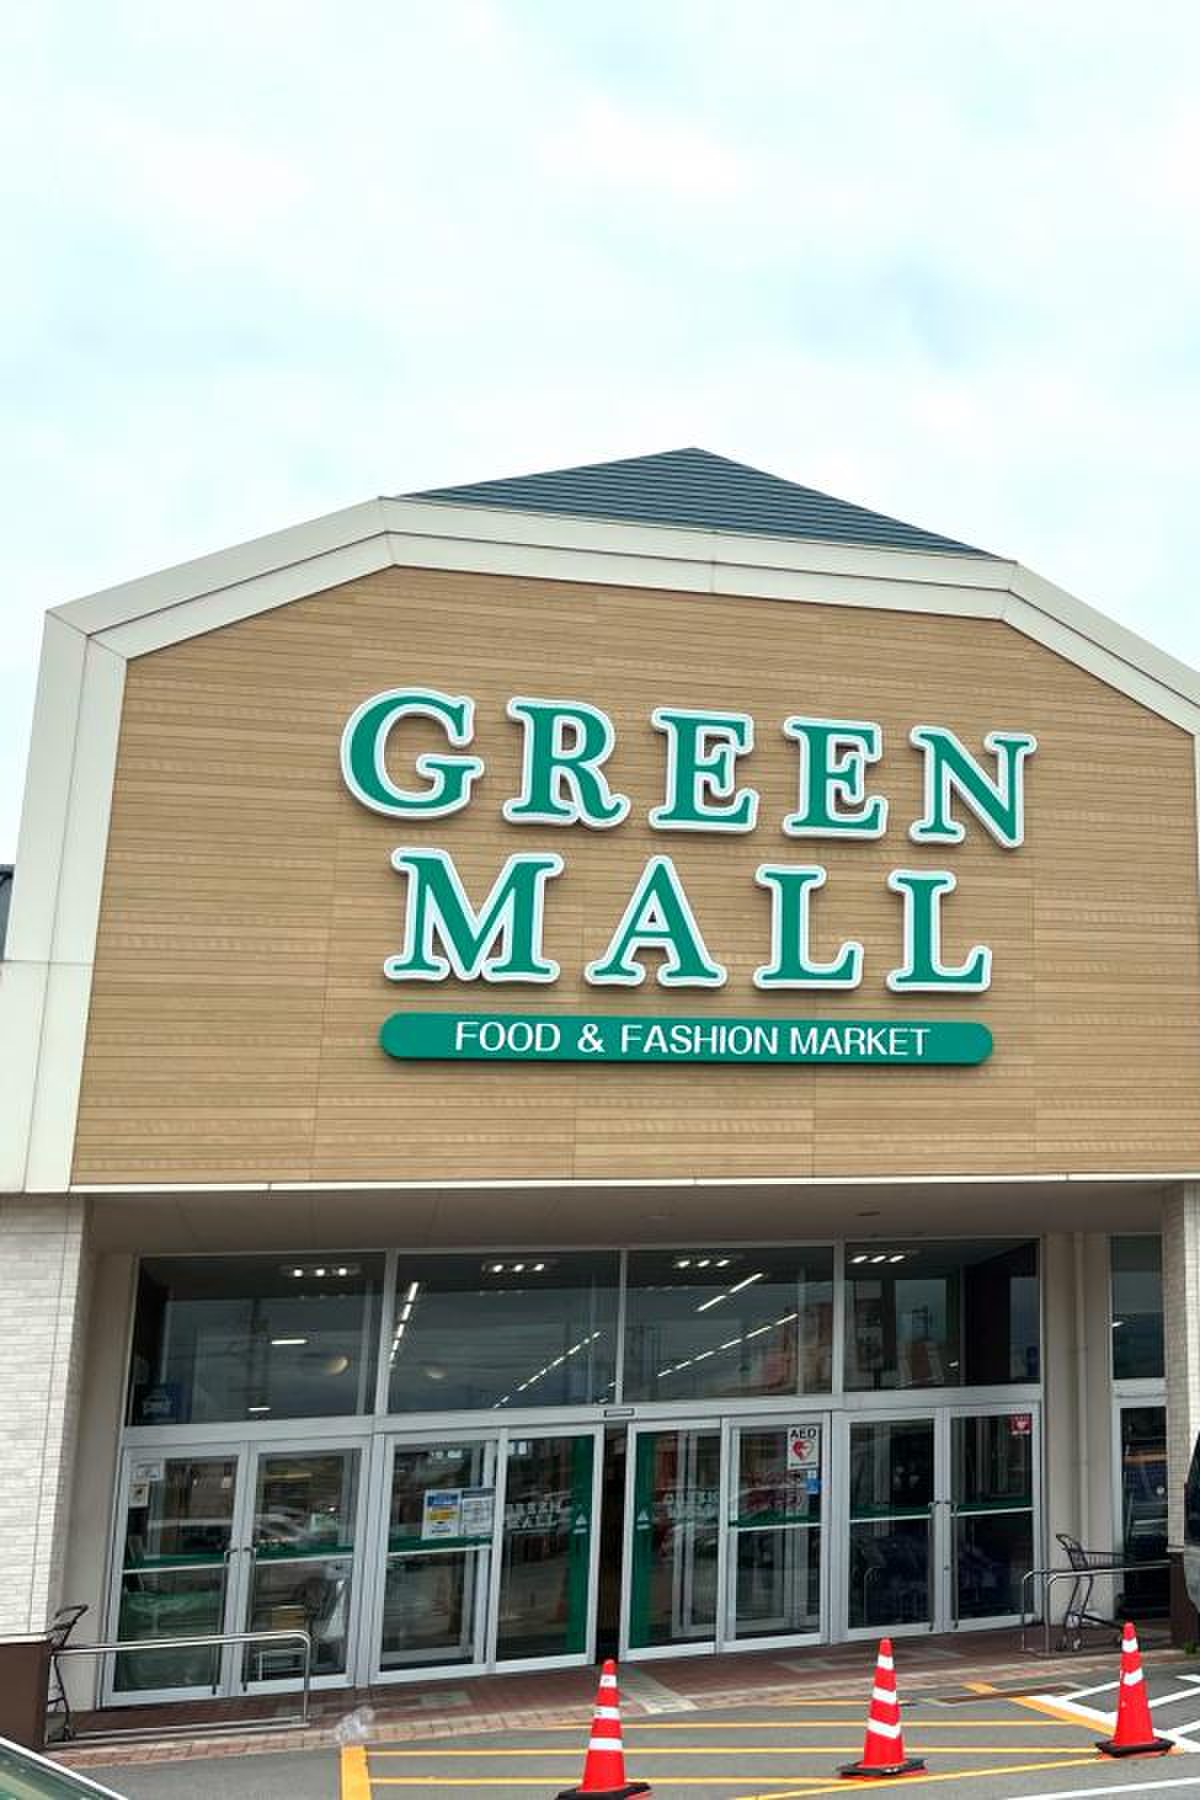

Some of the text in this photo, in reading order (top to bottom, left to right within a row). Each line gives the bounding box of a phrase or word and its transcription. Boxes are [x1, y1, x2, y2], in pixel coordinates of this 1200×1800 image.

[340, 687, 1038, 848] GREEN
[383, 847, 993, 992] MALL
[454, 1020, 931, 1057] FOOD & FASHION MARKET
[790, 1428, 817, 1439] AED
